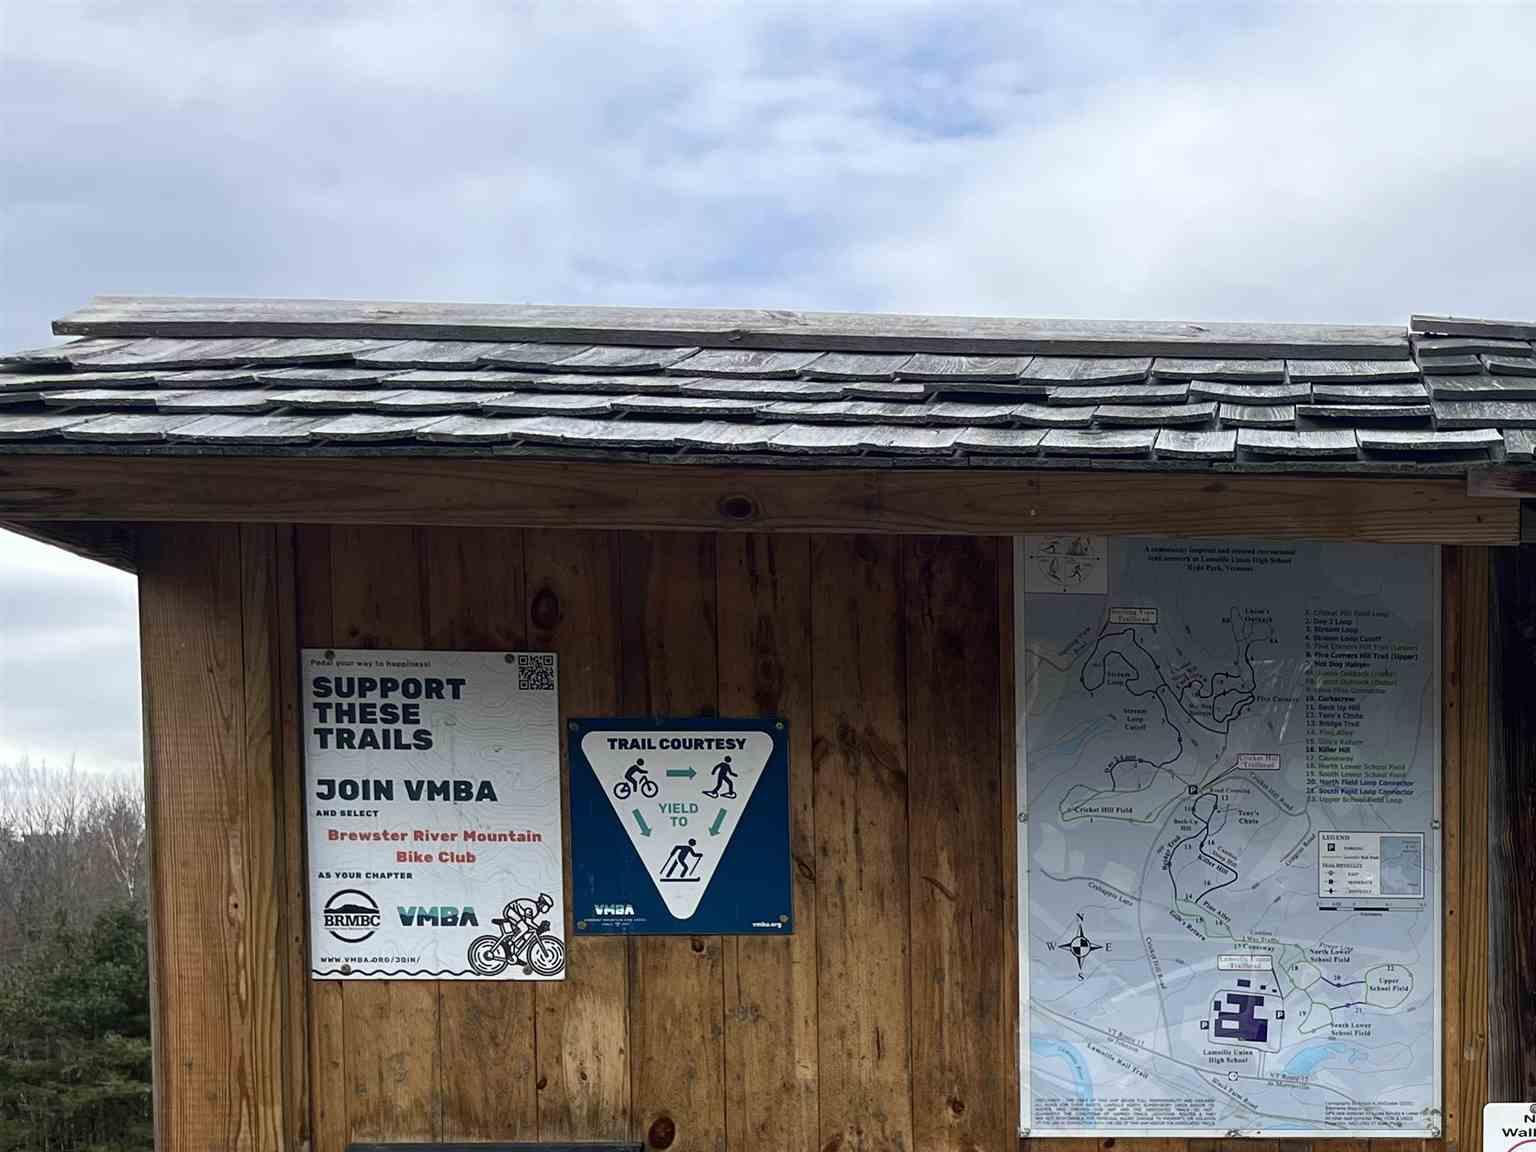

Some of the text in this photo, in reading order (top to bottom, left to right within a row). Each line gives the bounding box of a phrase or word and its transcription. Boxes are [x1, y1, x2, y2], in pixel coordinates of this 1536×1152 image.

[312, 676, 465, 699] SUPPORT
[314, 703, 421, 725] THESE
[314, 728, 433, 750] TRAILS
[607, 738, 746, 750] TRAIL COURTESY
[316, 779, 498, 801] JOIN VMBA
[659, 803, 698, 814] YIELD
[670, 817, 687, 827] TO
[328, 829, 542, 842] Brewster River Mountain
[396, 851, 475, 863] Bike Club
[594, 904, 635, 915] VMBA
[324, 915, 380, 927] BRMBC
[398, 906, 478, 927] VMBA
[1076, 913, 1084, 921] N
[1047, 943, 1112, 951] W E
